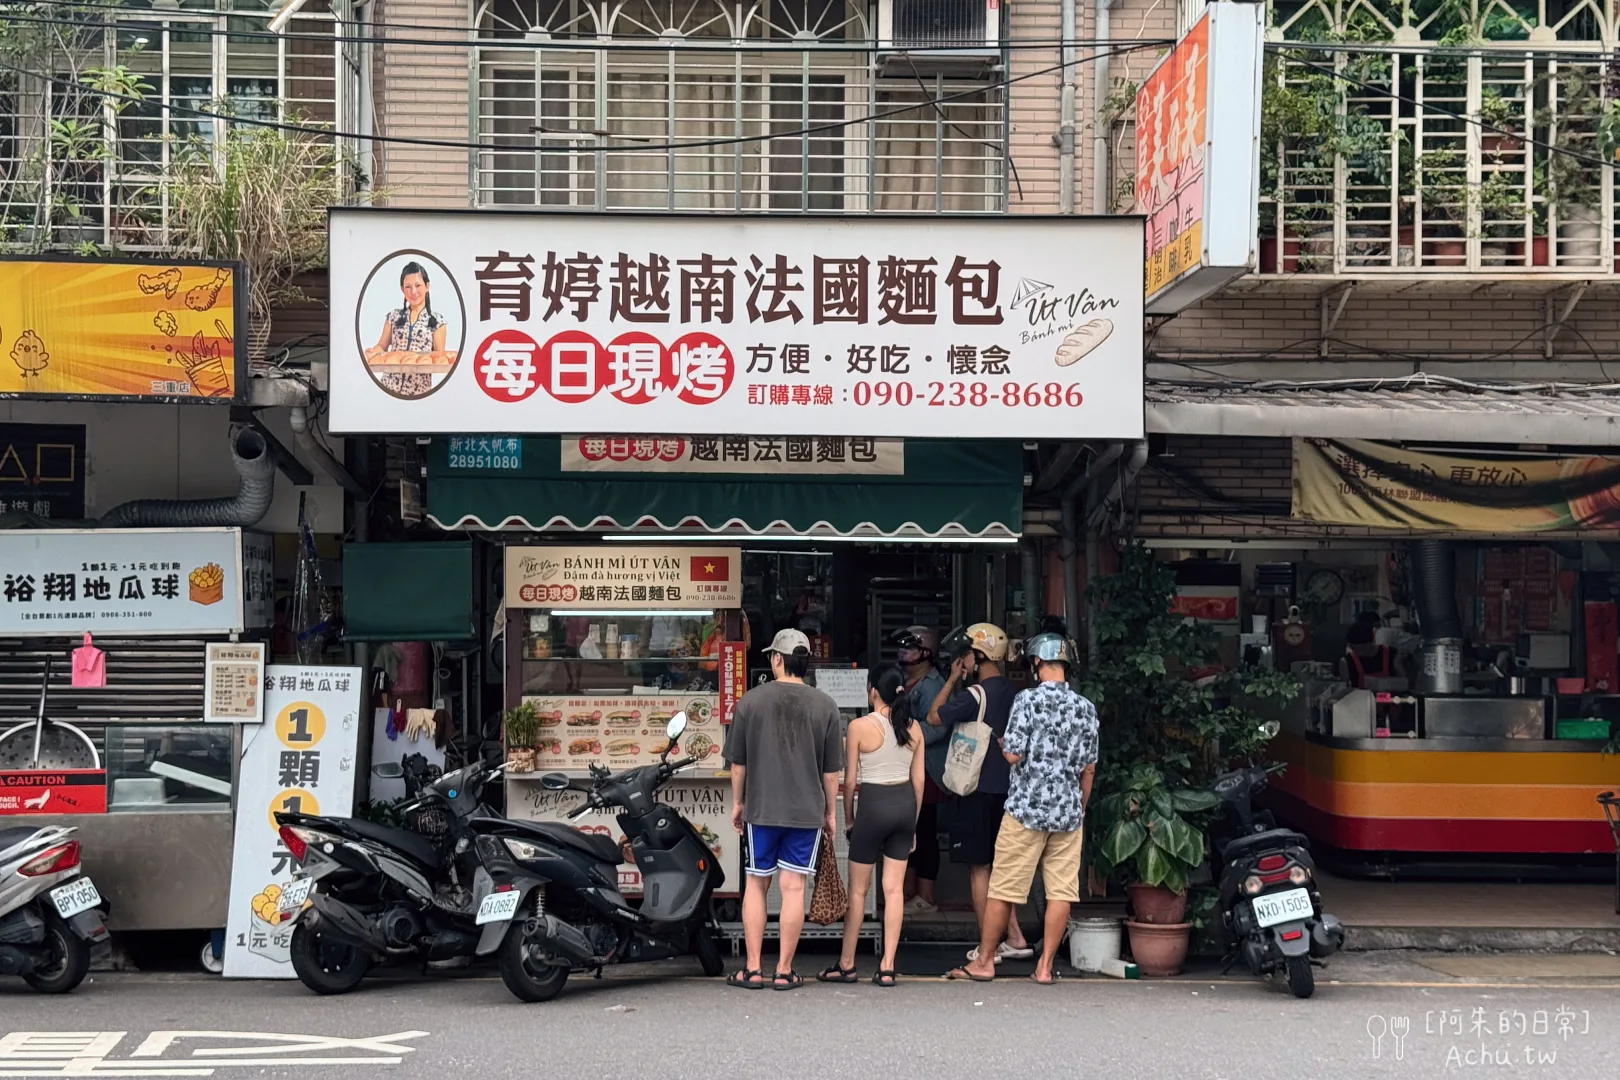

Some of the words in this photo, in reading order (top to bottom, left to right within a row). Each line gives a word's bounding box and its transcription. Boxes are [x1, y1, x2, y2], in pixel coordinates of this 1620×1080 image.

[1169, 217, 1178, 273] 咖啡
[1154, 228, 1162, 286] 三明治
[473, 250, 1004, 326] 育婷越南法國麵包
[1025, 292, 1065, 326] Út
[1066, 288, 1120, 318] Vân
[1019, 324, 1054, 345] Bánh
[479, 339, 729, 400] 每日現烤
[150, 380, 191, 394] 三重店
[853, 382, 1084, 408] 090-238-8686
[449, 437, 518, 454] 新北大帆布
[584, 437, 681, 460] 每日現烤
[690, 436, 877, 463] 越南法國麵包
[449, 454, 519, 469] 28951080
[1450, 465, 1528, 489] 更放心
[564, 555, 604, 569] BÁNH
[608, 555, 626, 569] MÌ
[630, 554, 650, 569] ÚT
[652, 555, 681, 569] VÂN
[564, 570, 588, 581] Đậm
[591, 570, 604, 580] đà
[607, 570, 644, 582] hương
[658, 571, 681, 582] Việt
[3, 572, 180, 603] 裕翔地瓜球
[521, 586, 575, 600] 每日現烤
[580, 585, 681, 601] 越南法國麵包
[7, 776, 66, 786] CAUTION
[665, 786, 687, 803] ÚT
[690, 785, 725, 803] VÂN
[699, 803, 725, 816] Việt
[1257, 895, 1309, 919] NXD-1505
